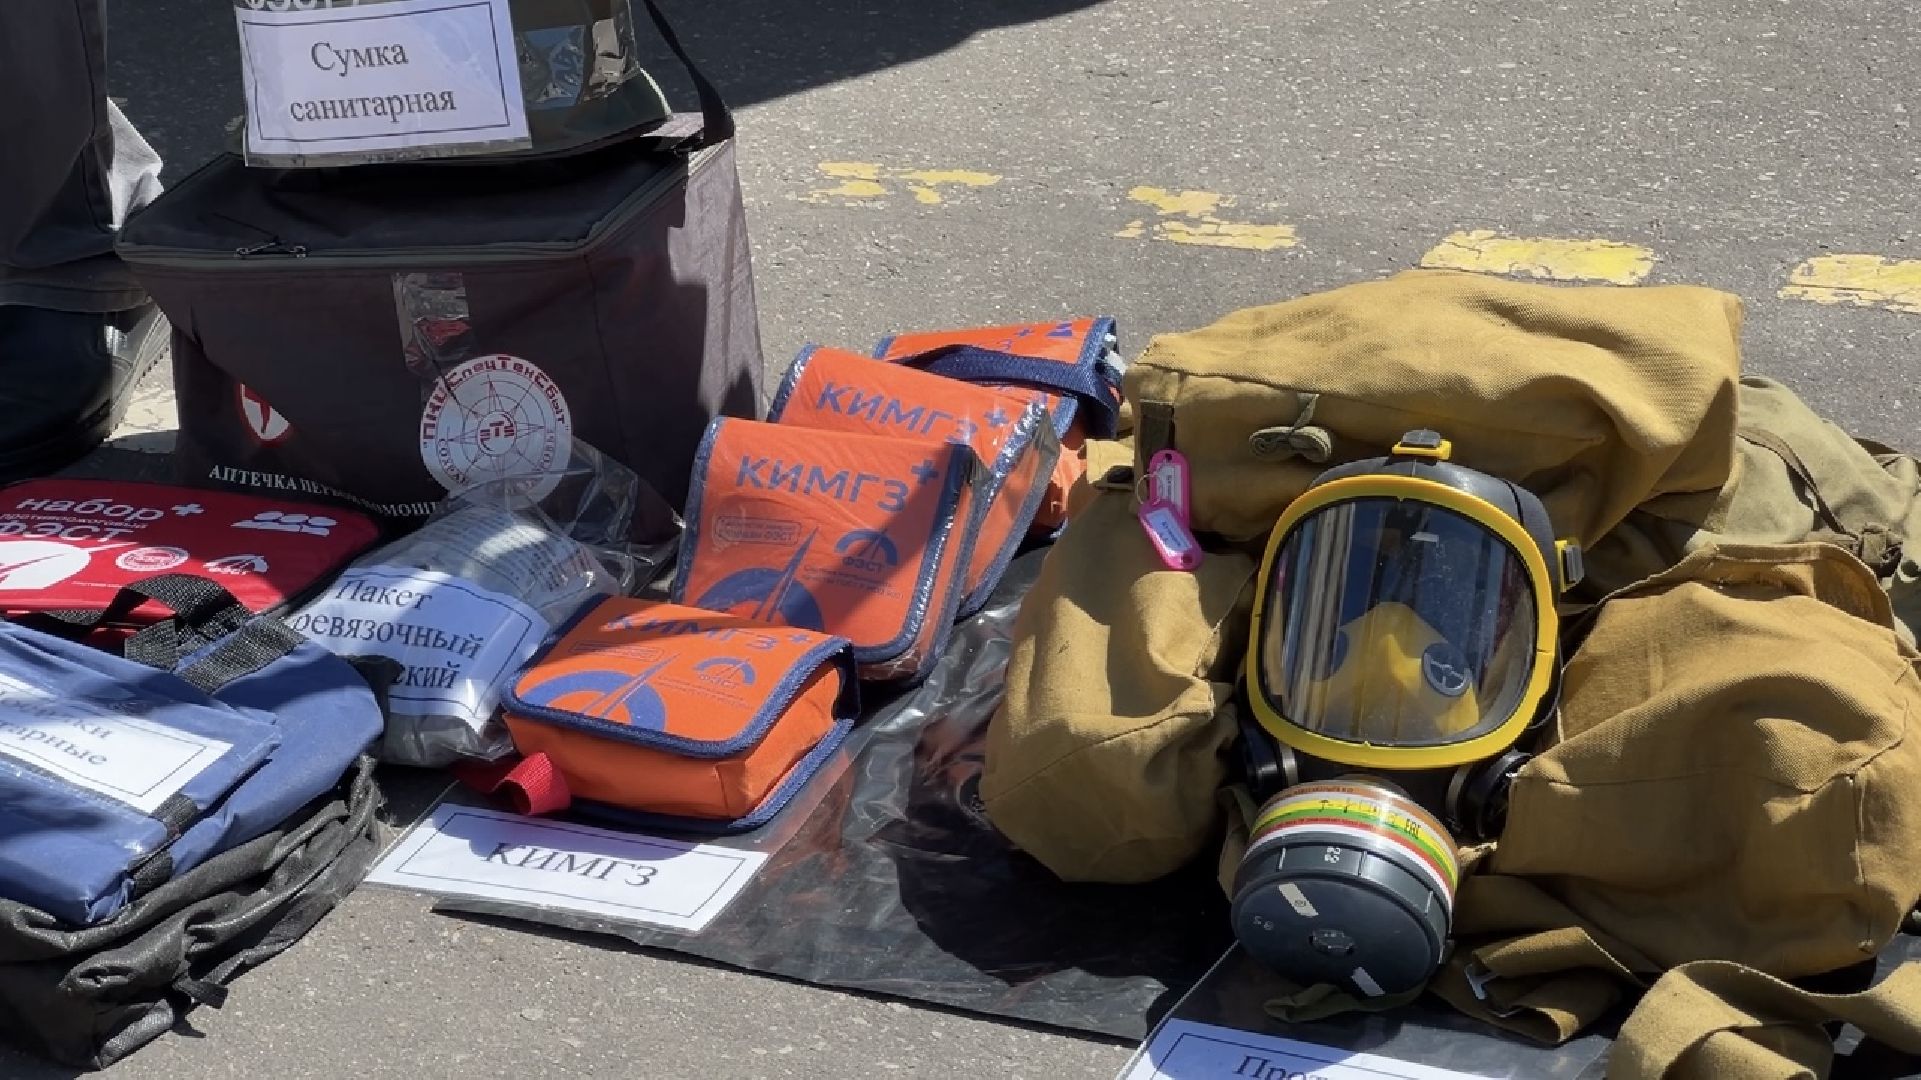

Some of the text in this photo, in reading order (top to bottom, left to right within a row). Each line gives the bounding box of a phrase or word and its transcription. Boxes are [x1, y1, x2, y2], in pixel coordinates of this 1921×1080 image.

[311, 40, 409, 76] Сумка
[290, 87, 457, 122] санитарная
[815, 382, 979, 445] КИМГЗ
[208, 464, 298, 491] АПТЕЧКА
[736, 455, 909, 512] КИМГЗ
[16, 498, 165, 521] набор
[335, 578, 433, 611] Пакет
[292, 612, 484, 661] ревязочный
[481, 842, 659, 886] КИМГЗ
